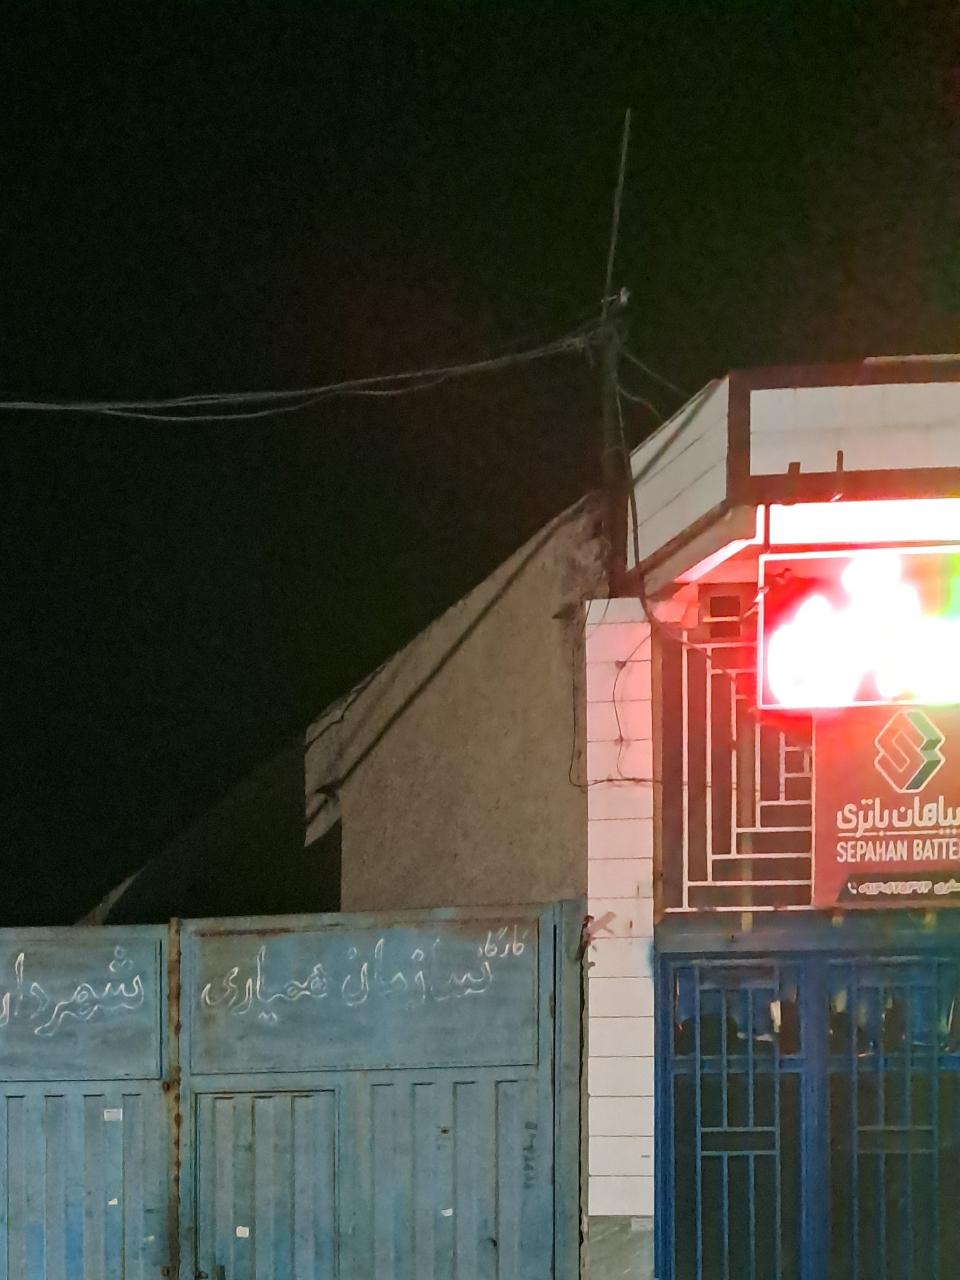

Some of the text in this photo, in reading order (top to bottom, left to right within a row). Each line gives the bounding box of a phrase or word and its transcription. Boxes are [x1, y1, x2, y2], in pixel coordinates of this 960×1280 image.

[836, 797, 890, 838] باتری
[836, 838, 960, 863] SEPAHAN BATTE
